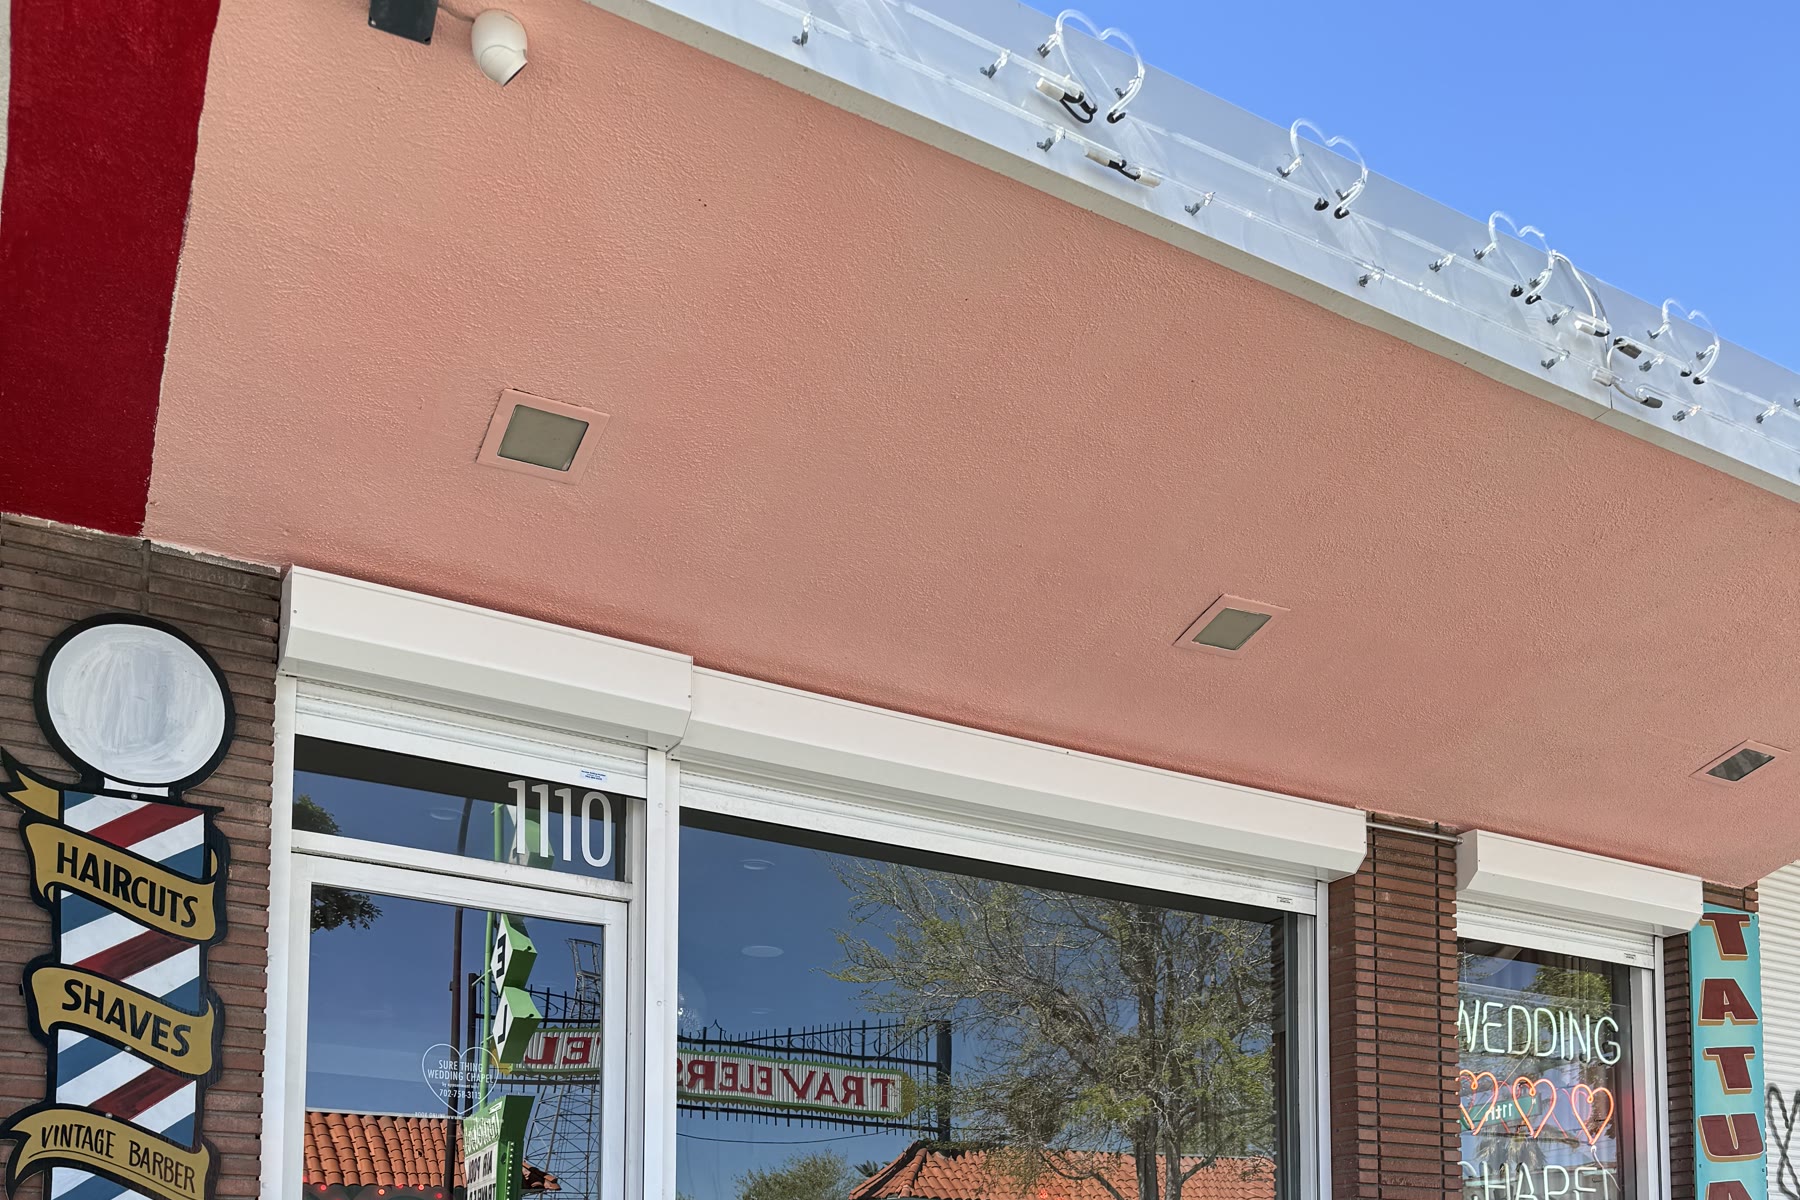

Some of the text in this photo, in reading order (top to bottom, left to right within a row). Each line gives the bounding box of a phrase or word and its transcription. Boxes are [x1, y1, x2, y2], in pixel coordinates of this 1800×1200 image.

[508, 780, 612, 867] 1110
[57, 842, 199, 928] HAIRCUTS
[62, 979, 192, 1057] SHAVES
[1458, 999, 1622, 1065] WEDDING
[427, 1069, 494, 1084] WEDDING CHAPEL
[438, 1060, 483, 1073] SURE THING
[41, 1124, 195, 1194] VINTAGE BARBER
